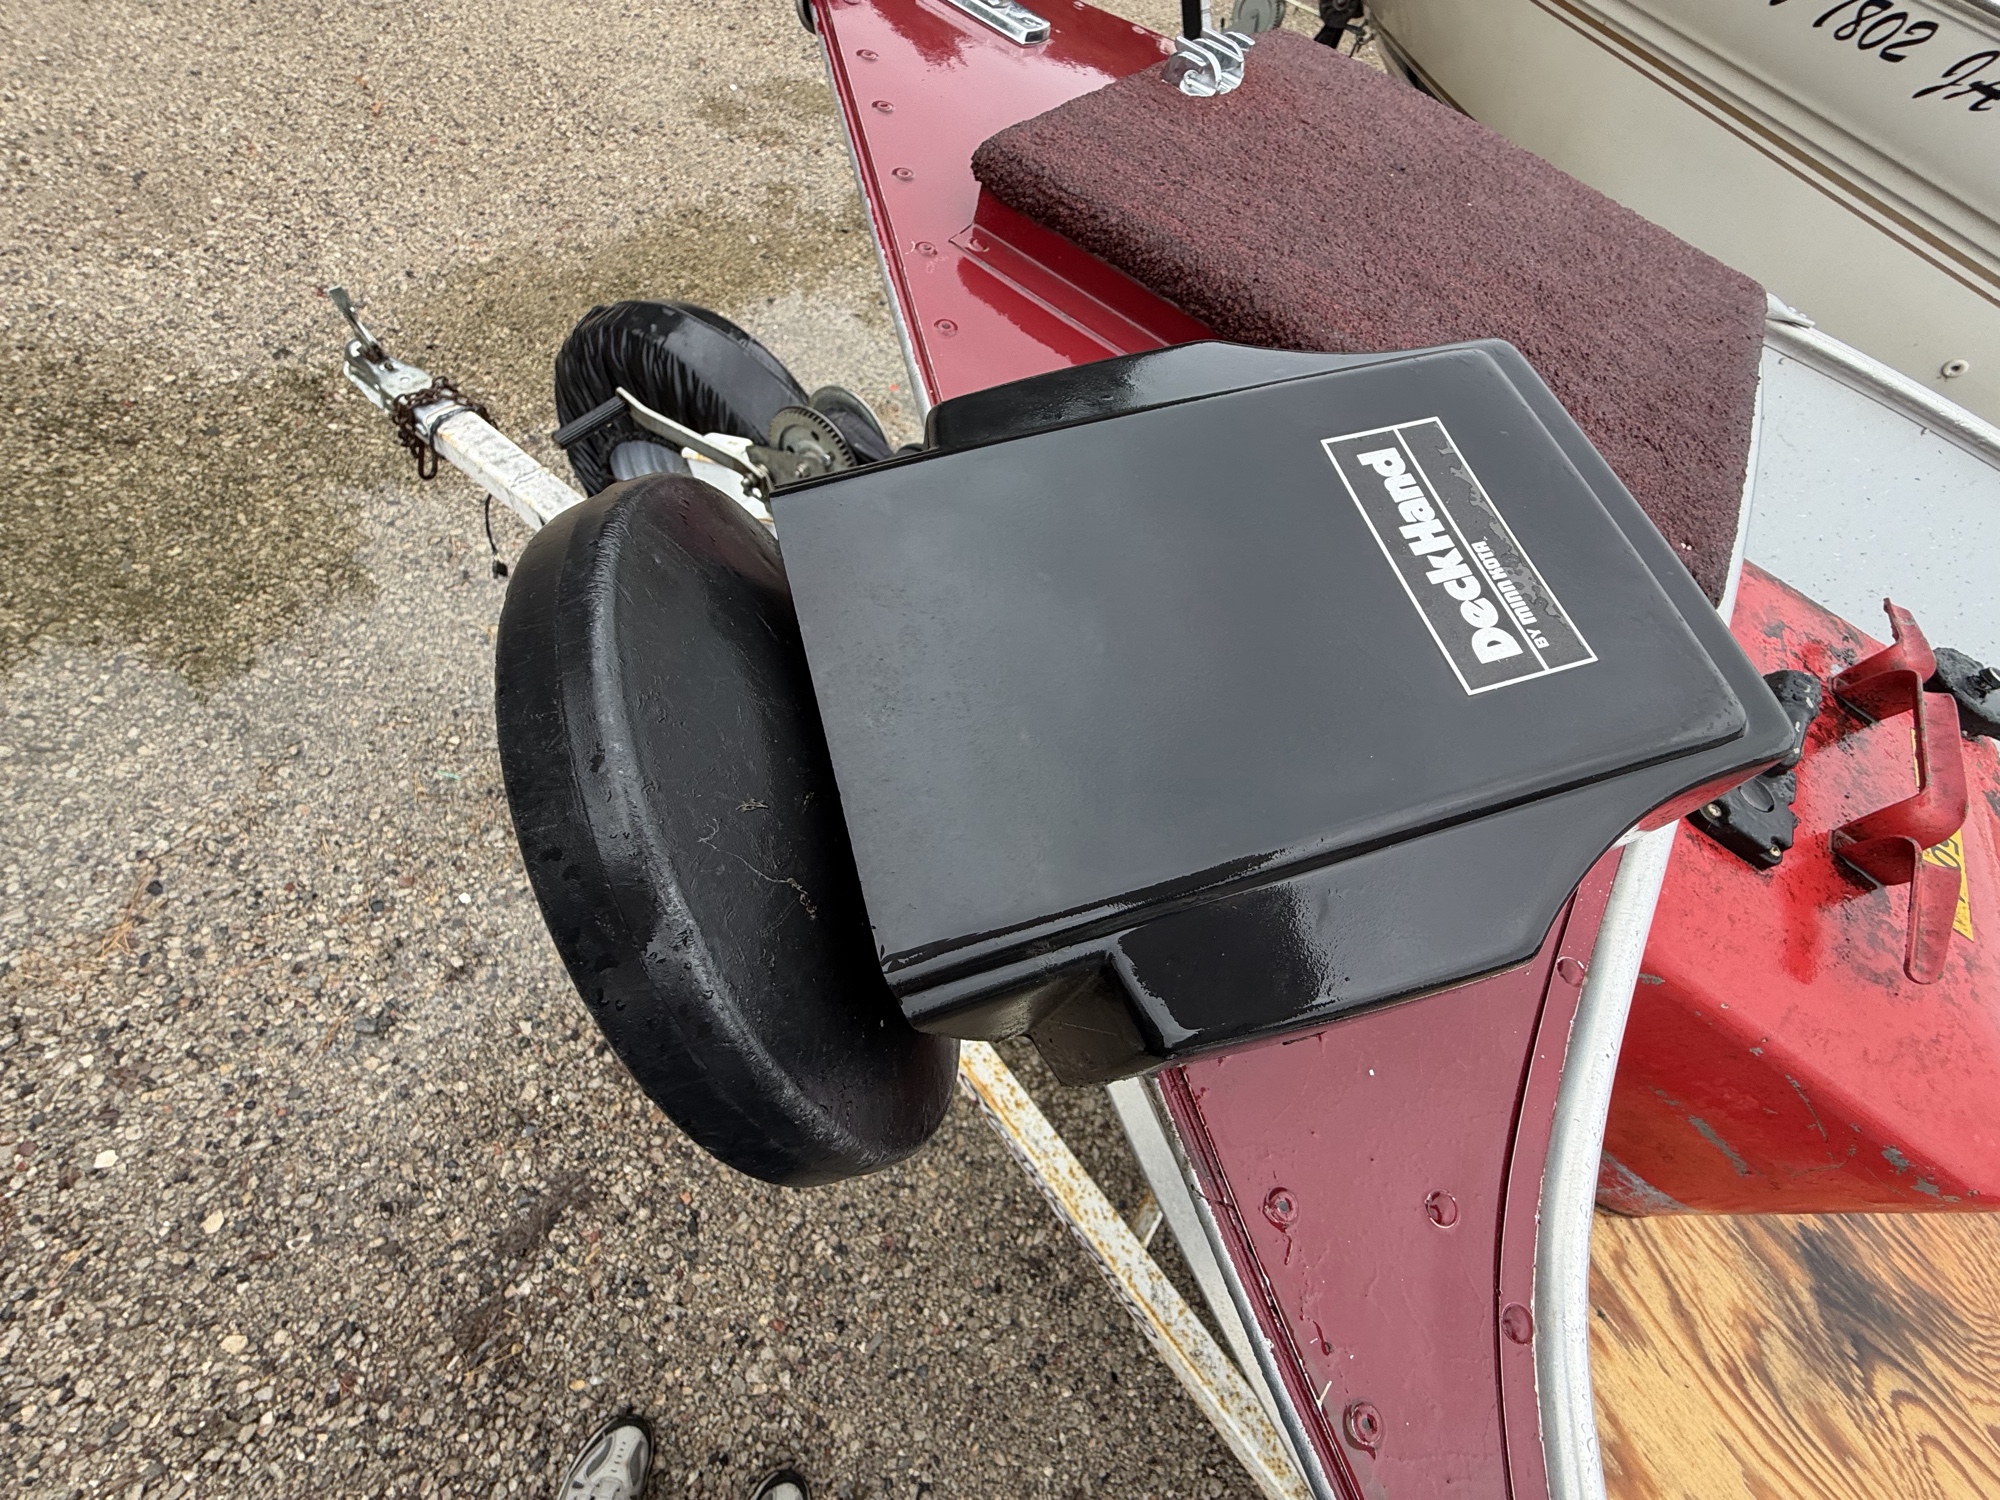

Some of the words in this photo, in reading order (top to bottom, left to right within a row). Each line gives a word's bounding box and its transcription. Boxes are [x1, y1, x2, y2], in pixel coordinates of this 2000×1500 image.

[1356, 447, 1524, 665] DeckHand
[1471, 540, 1508, 581] KOTA
[1526, 628, 1550, 649] BY
